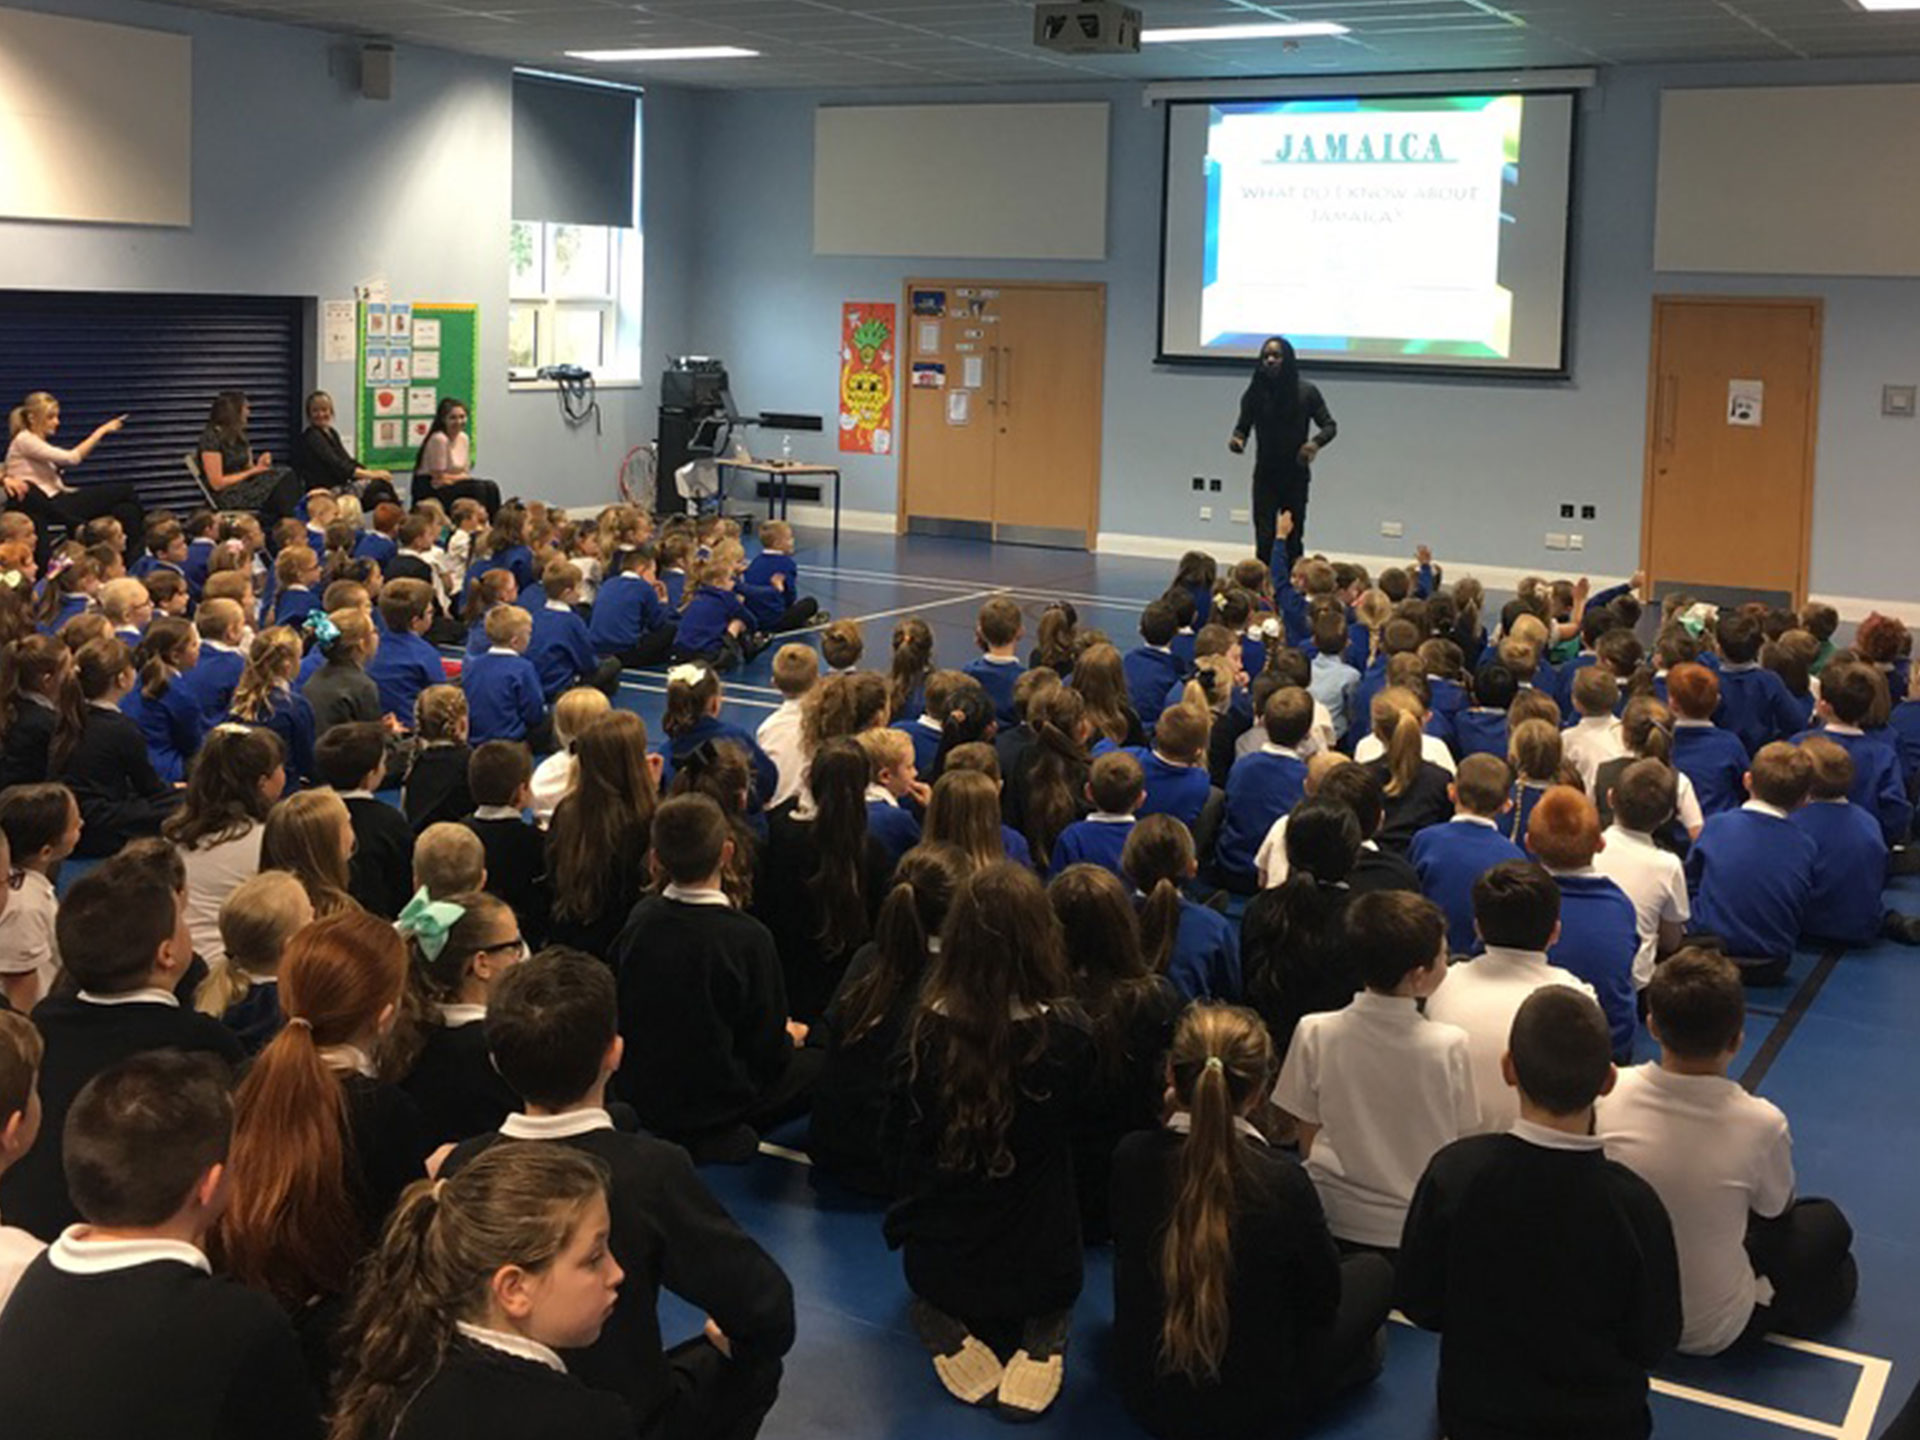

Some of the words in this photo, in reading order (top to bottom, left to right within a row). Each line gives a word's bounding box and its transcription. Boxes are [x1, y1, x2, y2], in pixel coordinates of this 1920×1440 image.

[1276, 133, 1443, 161] JAMAICA
[1241, 185, 1296, 200] WHAT
[1302, 185, 1330, 200] DO
[1345, 185, 1408, 200] KNOW
[1413, 186, 1480, 201] ABOUT
